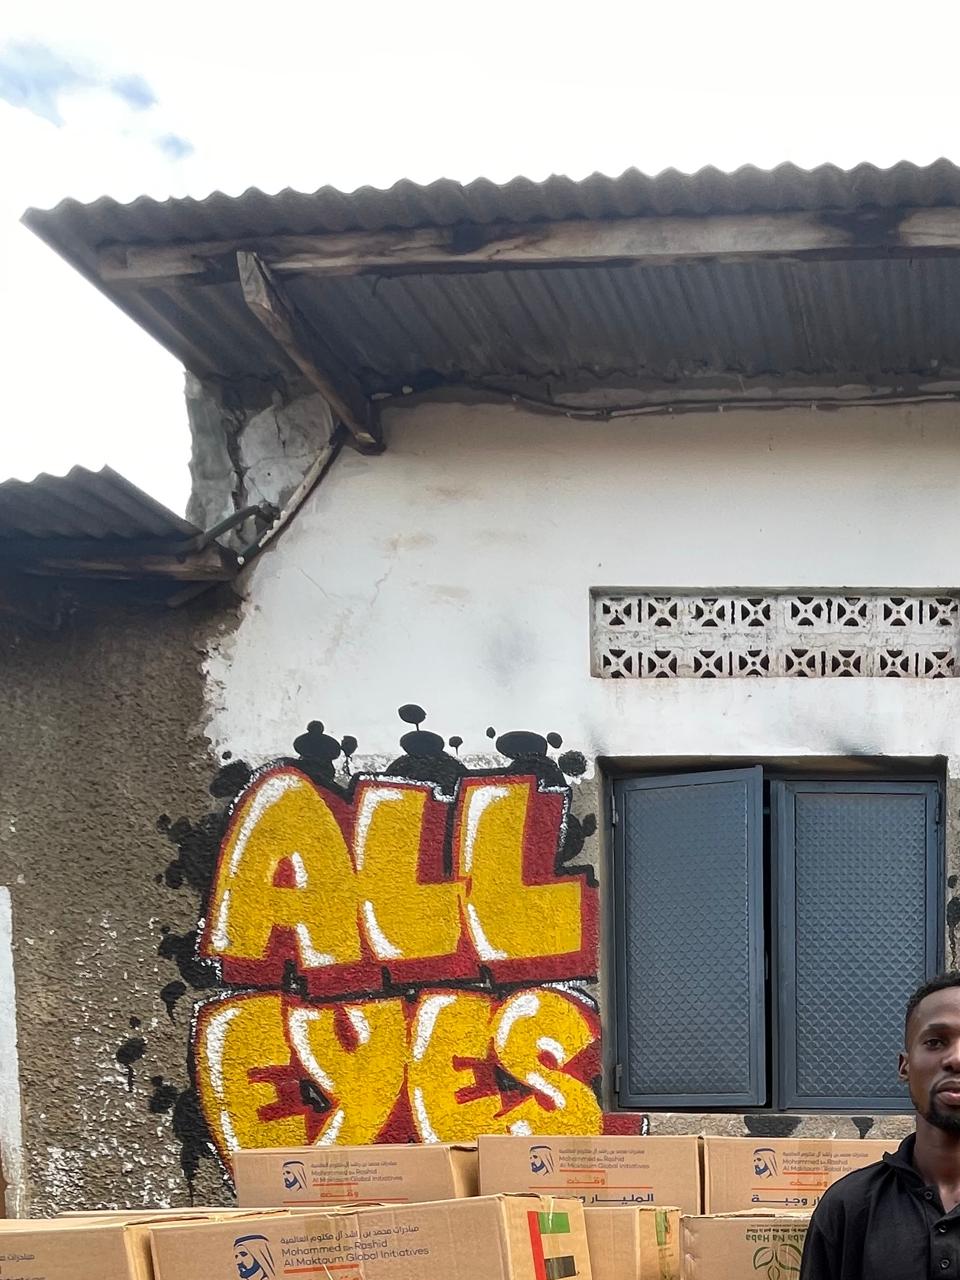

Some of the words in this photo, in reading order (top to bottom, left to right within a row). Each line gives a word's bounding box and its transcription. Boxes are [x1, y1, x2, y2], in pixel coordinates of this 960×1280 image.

[206, 766, 592, 978] ALL
[197, 987, 602, 1149] EYES
[281, 1243, 341, 1257] Mohammed
[354, 1238, 387, 1250] Rashid
[295, 1254, 344, 1267] Maktoum
[345, 1250, 379, 1262] Global
[379, 1245, 429, 1259] Initiatives
